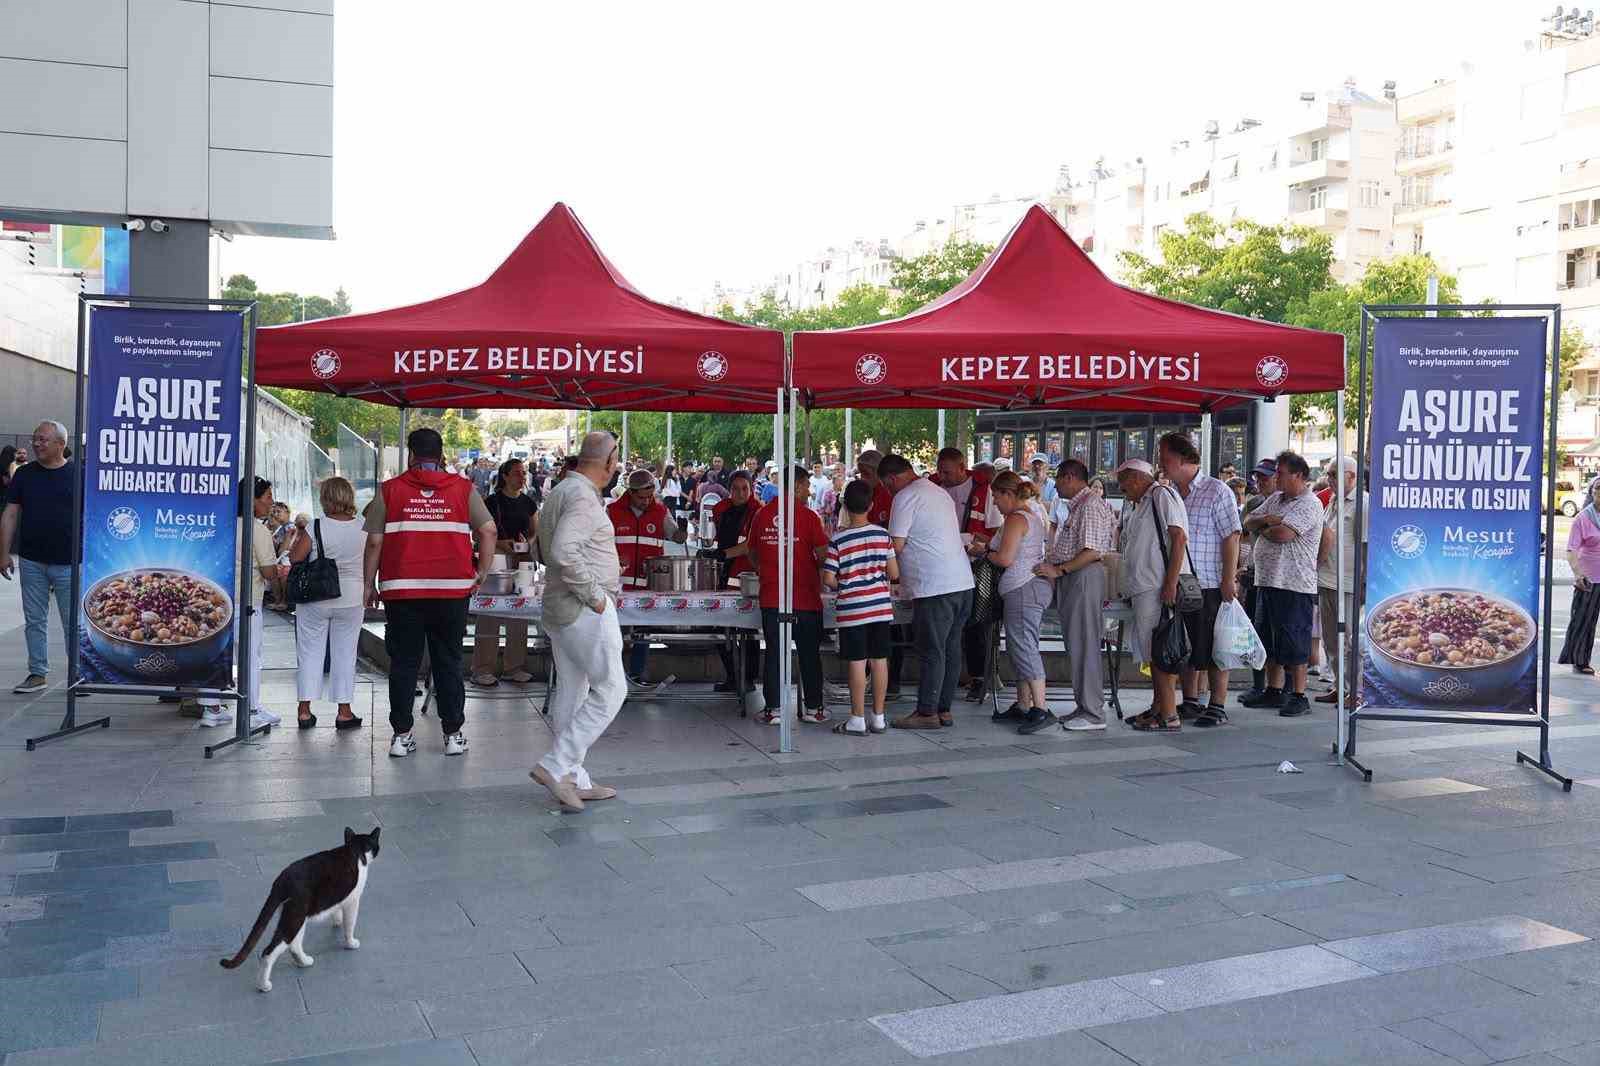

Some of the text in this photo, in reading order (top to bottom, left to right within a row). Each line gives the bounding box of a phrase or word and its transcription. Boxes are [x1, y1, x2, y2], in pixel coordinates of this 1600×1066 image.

[114, 335, 221, 349] Birlik, beraberlik, dayanışma
[132, 347, 181, 357] paylaşmanın
[183, 348, 213, 358] simgesi
[1399, 347, 1519, 358] Birlik, beraberlik, dayanışma
[393, 343, 644, 374] KEPEZ BELEDİYESİ
[940, 350, 1200, 382] KEPEZ BELEDİYESİ
[1419, 358, 1475, 368] paylaşmanın
[1476, 358, 1510, 368] simgesi
[113, 376, 222, 425] AŞURE
[1398, 389, 1520, 439] AŞURE
[99, 423, 232, 468] GÜNÜMÜZ
[1382, 438, 1532, 482] GÜNÜMÜZ
[98, 466, 230, 495] MÜBAREK OLSUN
[1382, 483, 1531, 511] MÜBAREK OLSUN
[155, 508, 217, 527] Mesut
[1443, 525, 1515, 544] Mesut
